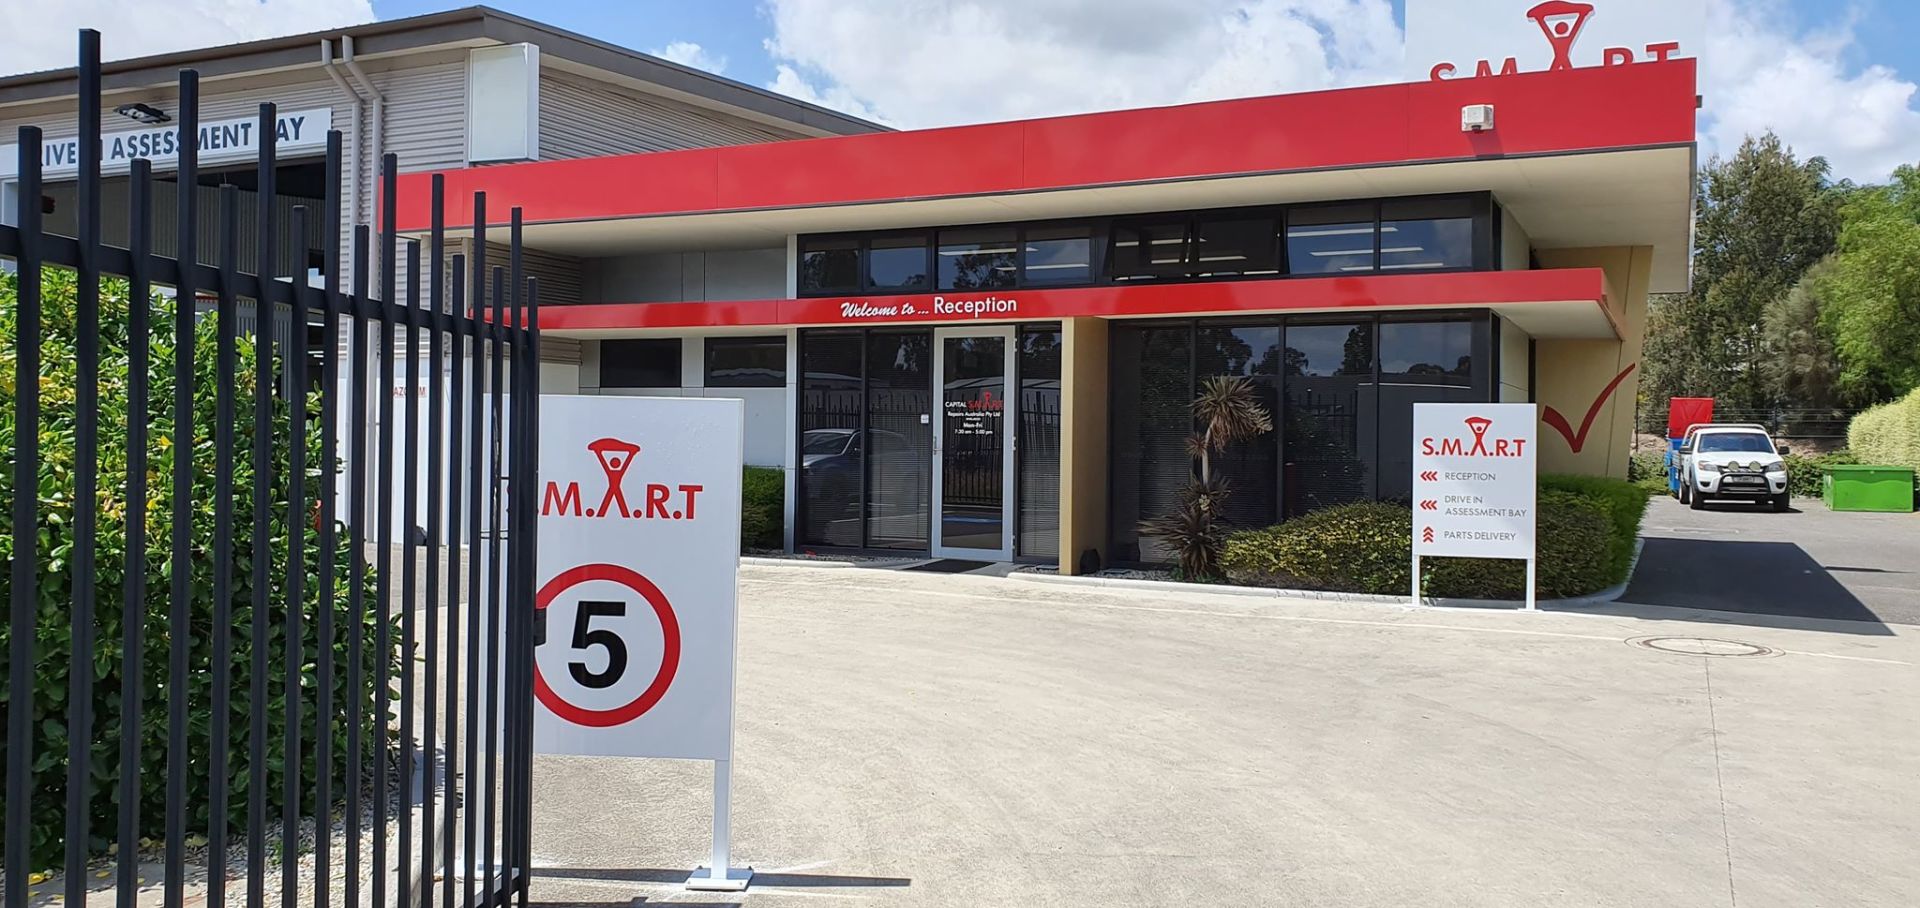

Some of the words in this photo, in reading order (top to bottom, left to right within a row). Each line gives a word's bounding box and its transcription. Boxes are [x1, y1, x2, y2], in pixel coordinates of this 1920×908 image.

[41, 142, 76, 168] IVE
[275, 116, 305, 142] AY
[840, 302, 898, 318] Welcome
[901, 302, 915, 315] to
[934, 296, 1017, 318] Reception
[1445, 472, 1496, 481] RECEPTION
[1445, 496, 1471, 504] DRIVE
[1473, 496, 1483, 504] IN
[1445, 508, 1506, 517] ASSESSMENT
[1508, 509, 1527, 517] BAY
[1444, 531, 1473, 540] PARTS
[1475, 532, 1516, 541] DELIVERY
[568, 601, 627, 688] 5
